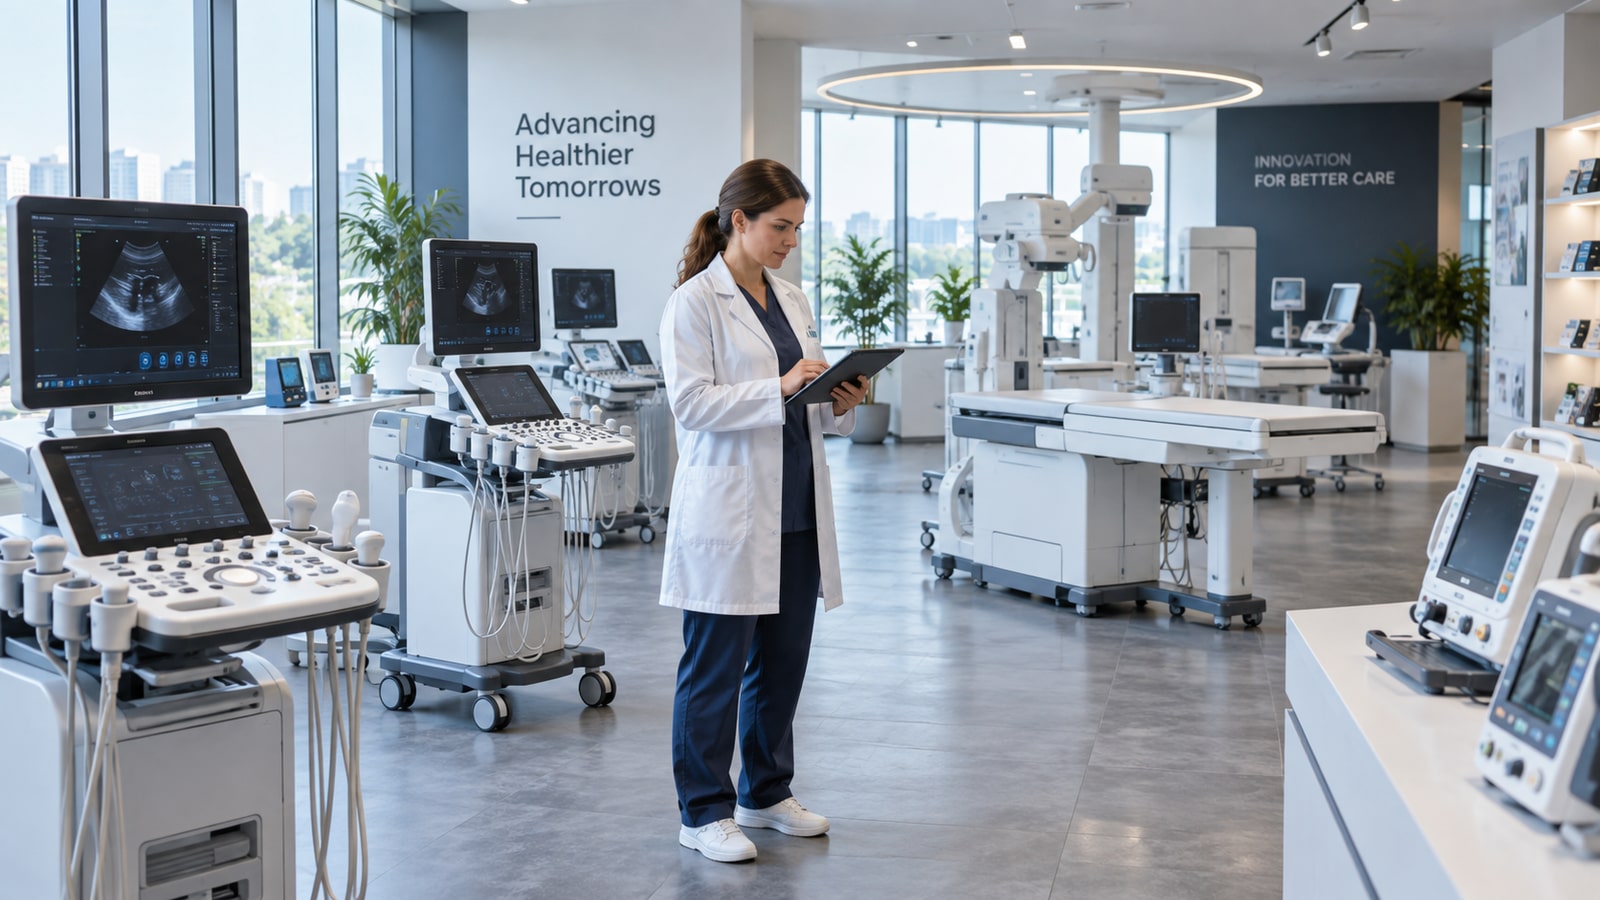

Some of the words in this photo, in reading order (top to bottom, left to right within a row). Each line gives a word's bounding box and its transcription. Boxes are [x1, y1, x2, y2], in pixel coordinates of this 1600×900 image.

[515, 109, 655, 138] Advancing
[516, 142, 634, 167] Healthier
[1254, 153, 1351, 168] INNOVATION
[515, 176, 661, 198] Tomorrows
[1254, 173, 1286, 187] FOR
[1290, 172, 1348, 187] BETTER
[1352, 171, 1396, 186] CARE
